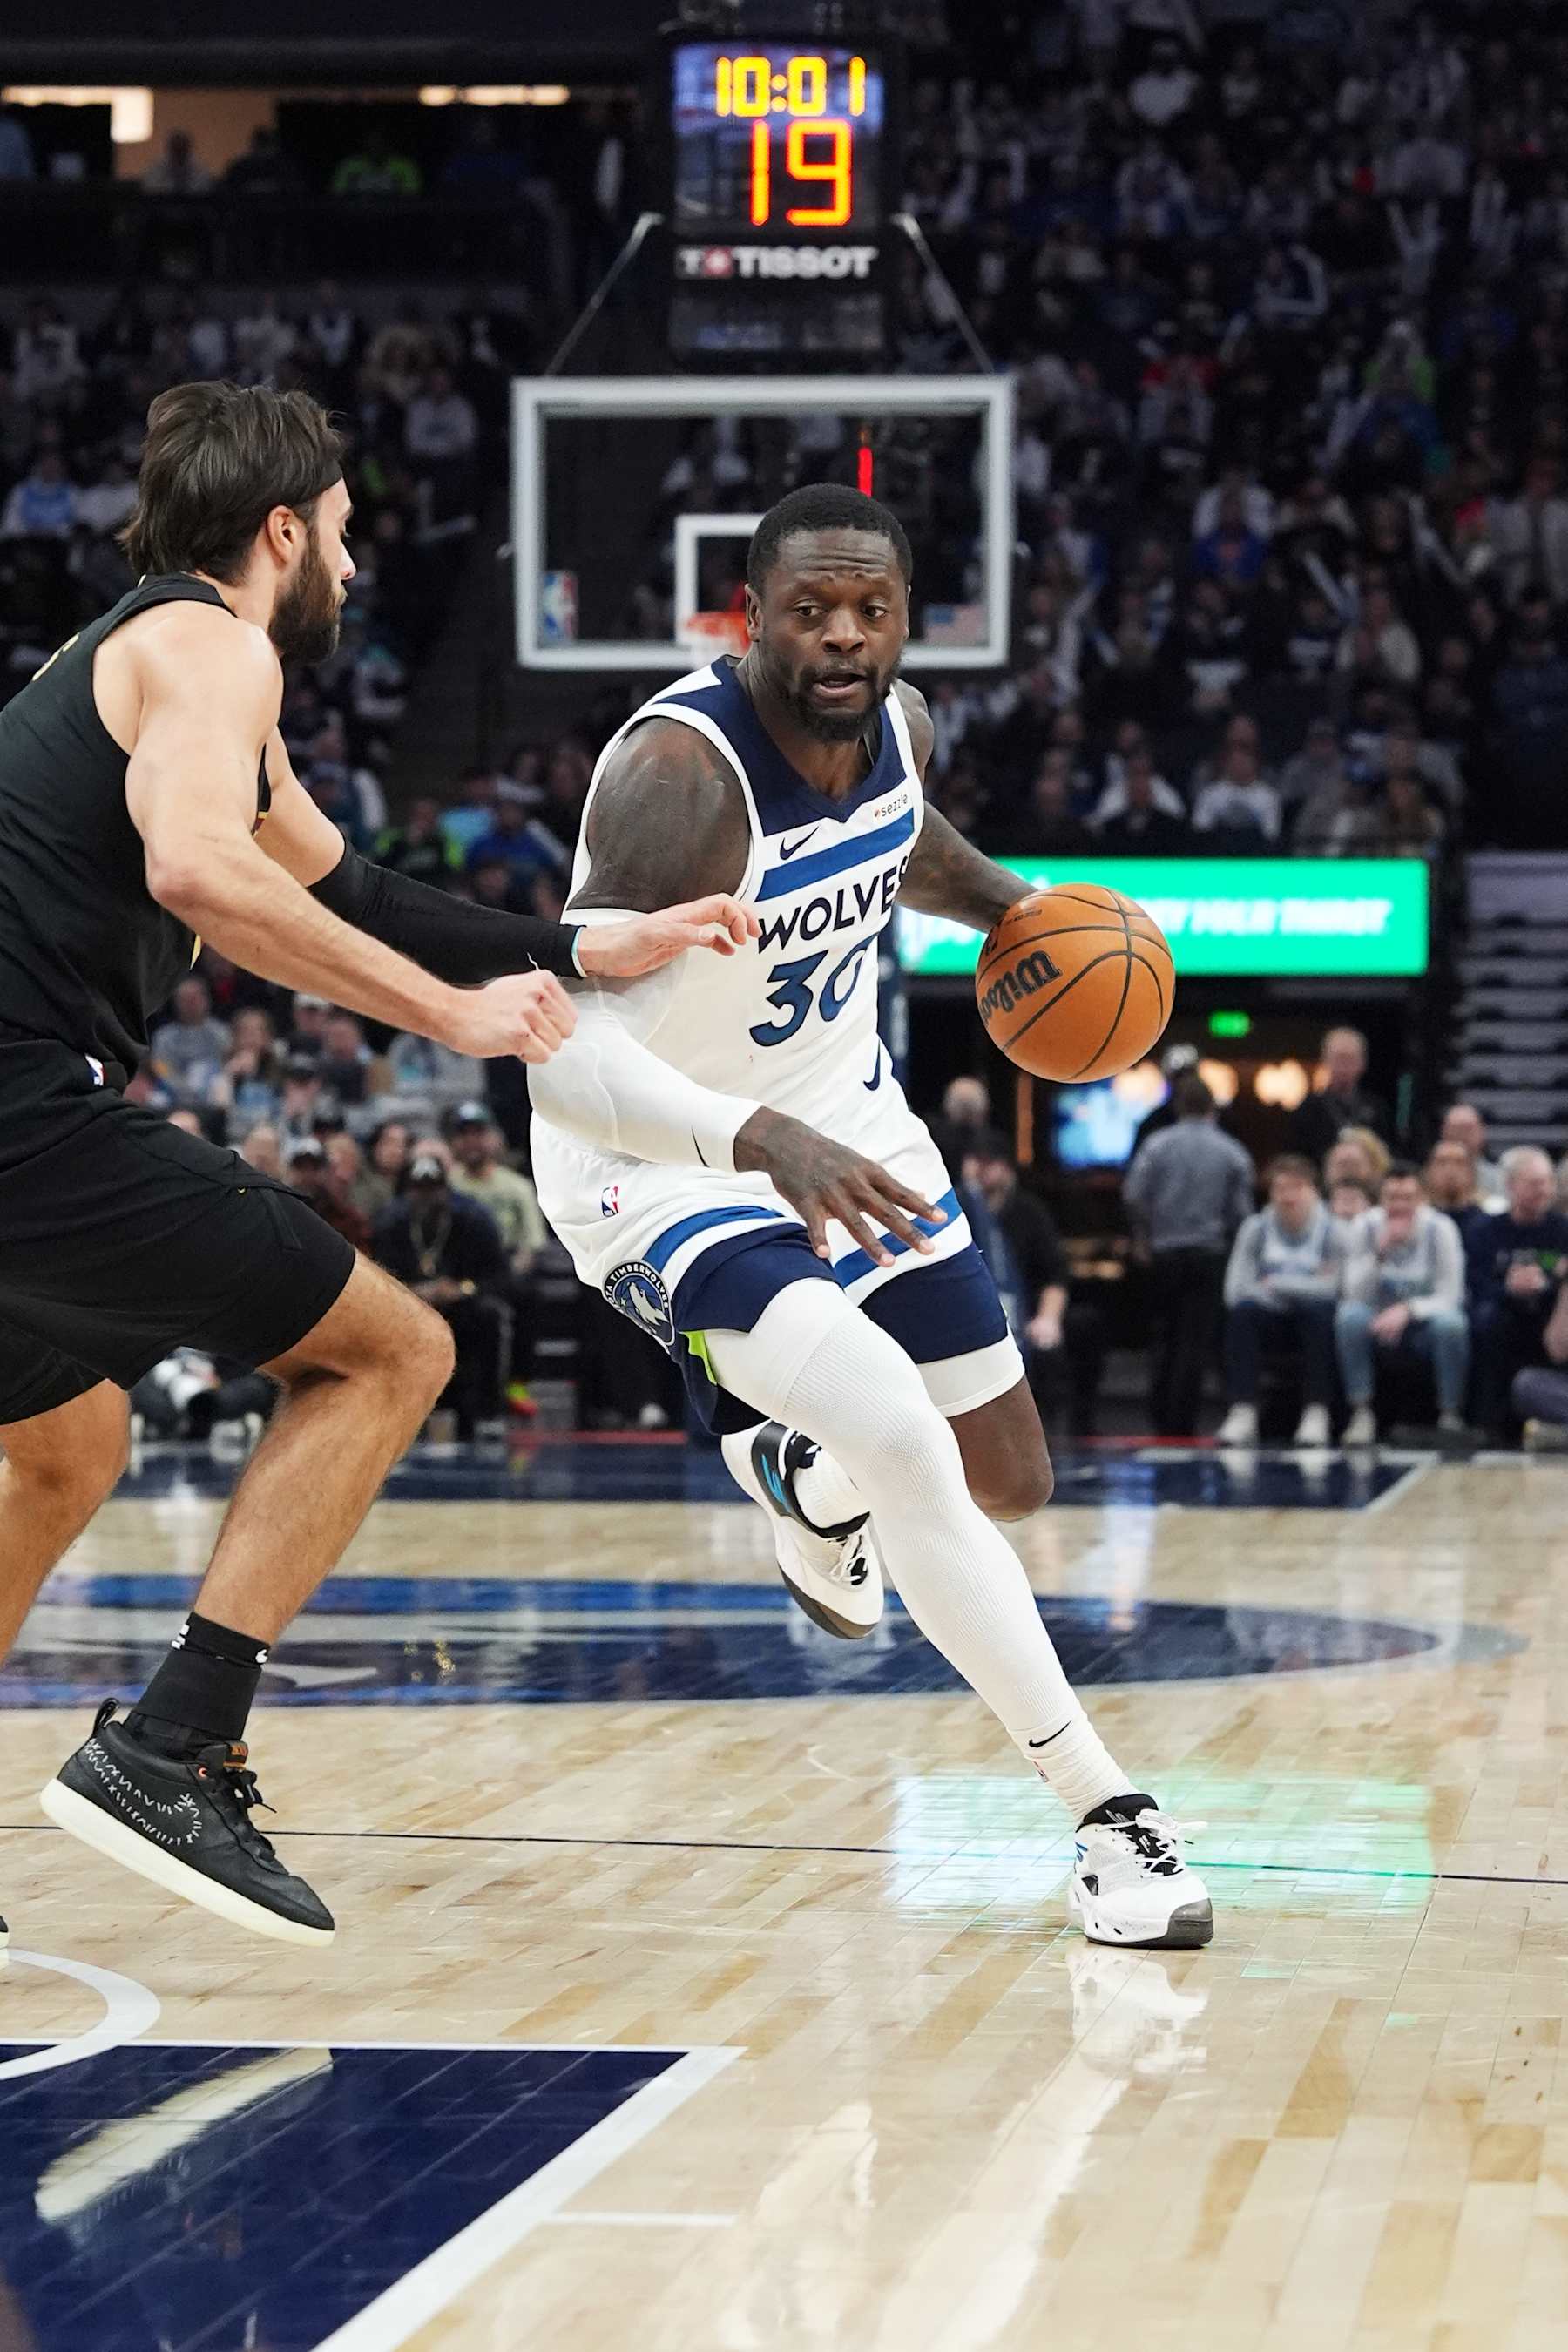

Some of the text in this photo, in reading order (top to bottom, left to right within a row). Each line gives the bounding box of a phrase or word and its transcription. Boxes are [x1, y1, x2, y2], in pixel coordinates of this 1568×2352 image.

[716, 57, 866, 118] 10:01
[750, 118, 853, 226] 19
[732, 245, 878, 279] TISSOT
[749, 932, 879, 1047] 30
[611, 1263, 669, 1308] TIMBERWOLVES
